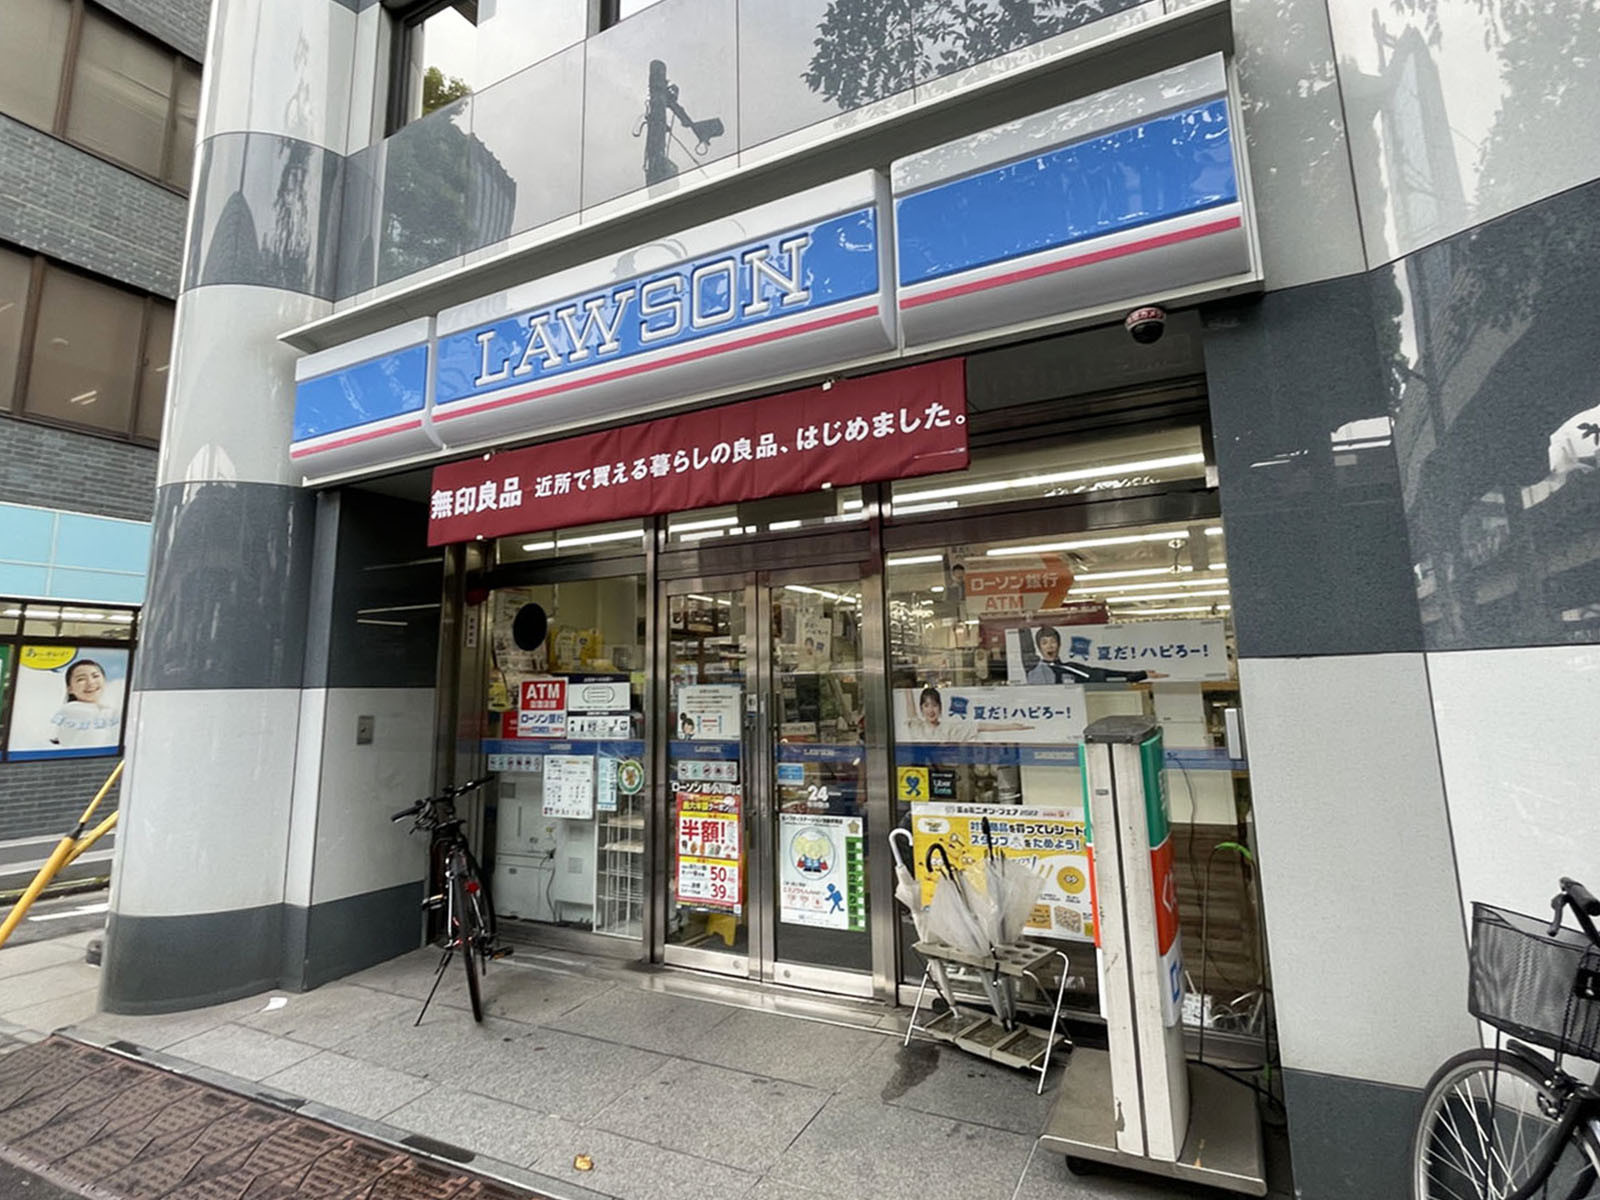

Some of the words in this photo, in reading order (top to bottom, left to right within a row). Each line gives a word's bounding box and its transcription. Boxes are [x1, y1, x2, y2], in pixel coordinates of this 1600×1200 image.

[474, 232, 812, 387] LAWSON
[430, 477, 523, 520] 無印良品
[534, 402, 967, 498] 近所で買える暮らしの良品、はじめました。
[985, 596, 1025, 611] ATM
[526, 683, 560, 700] ATM
[807, 785, 829, 801] 24
[681, 819, 725, 845] 半額！
[710, 866, 727, 882] 50
[710, 883, 727, 899] 39
